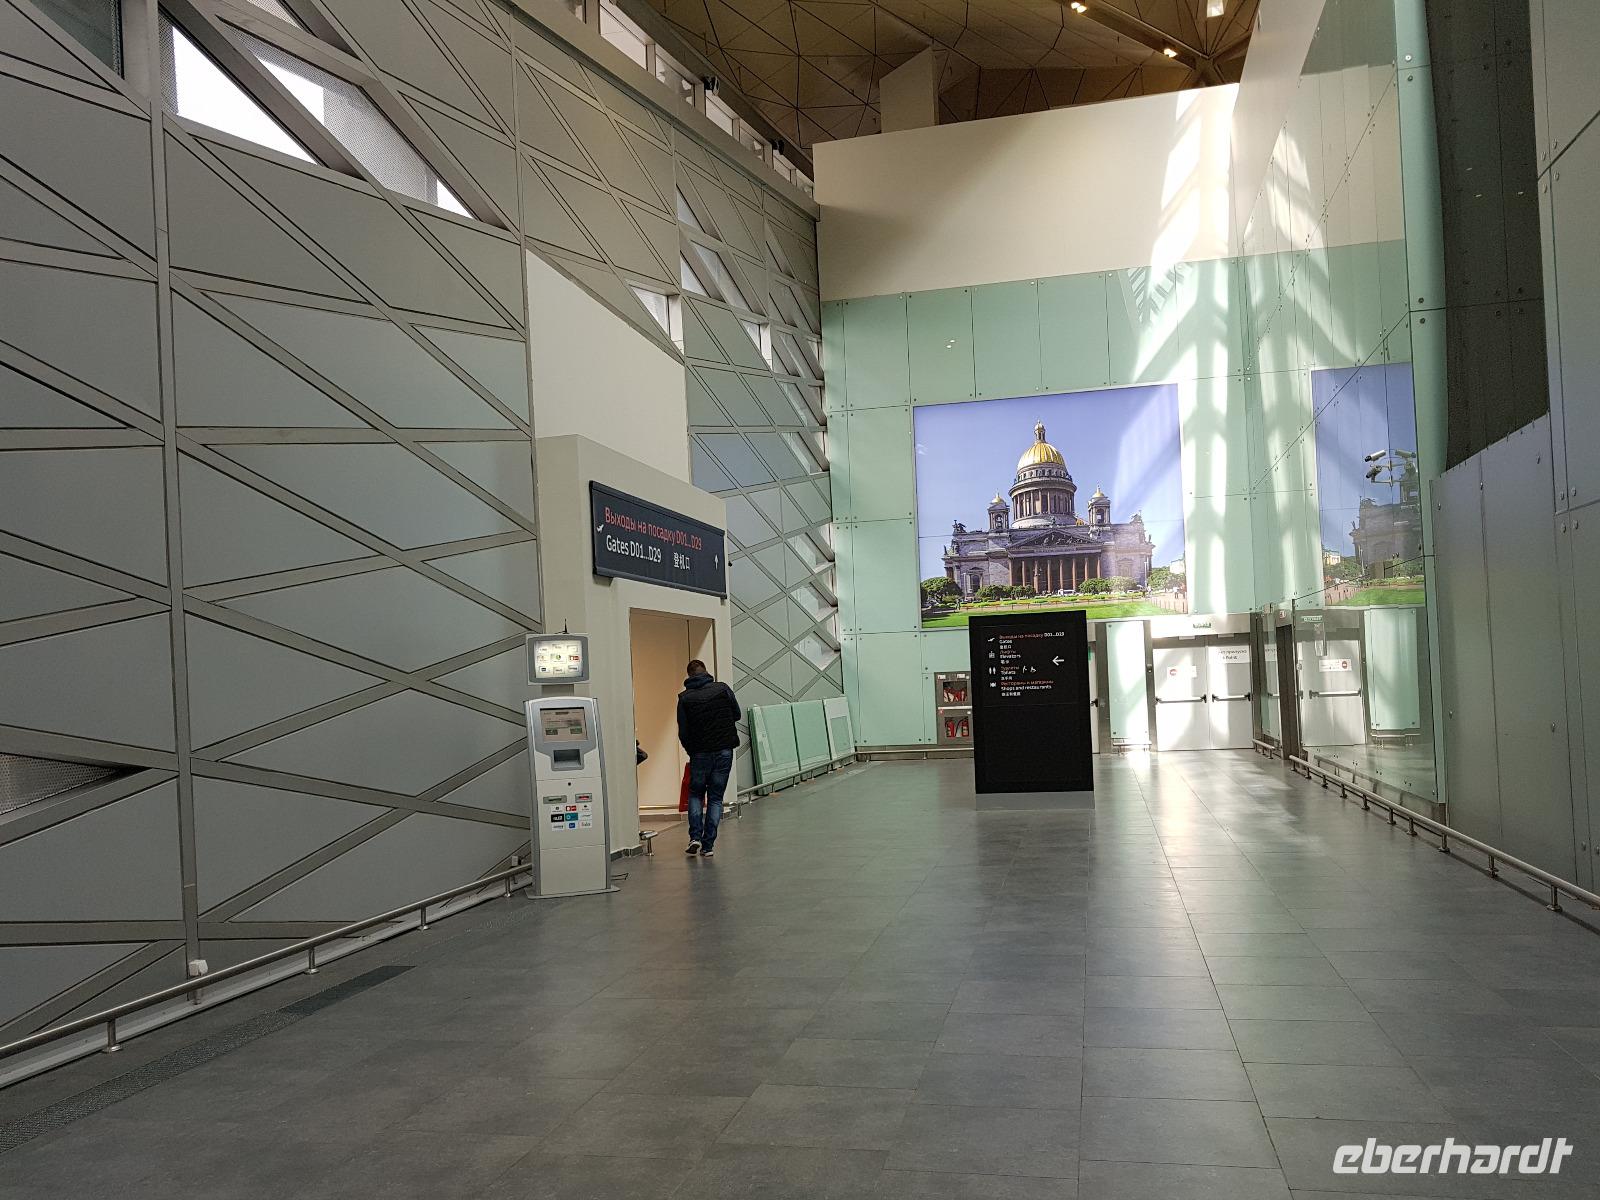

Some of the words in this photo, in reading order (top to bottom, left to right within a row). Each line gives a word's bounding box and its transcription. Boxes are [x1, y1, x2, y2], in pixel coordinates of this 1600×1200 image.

[605, 507, 636, 532] Выходы
[638, 523, 646, 534] на
[648, 524, 675, 546] посадку
[606, 535, 629, 555] Gates
